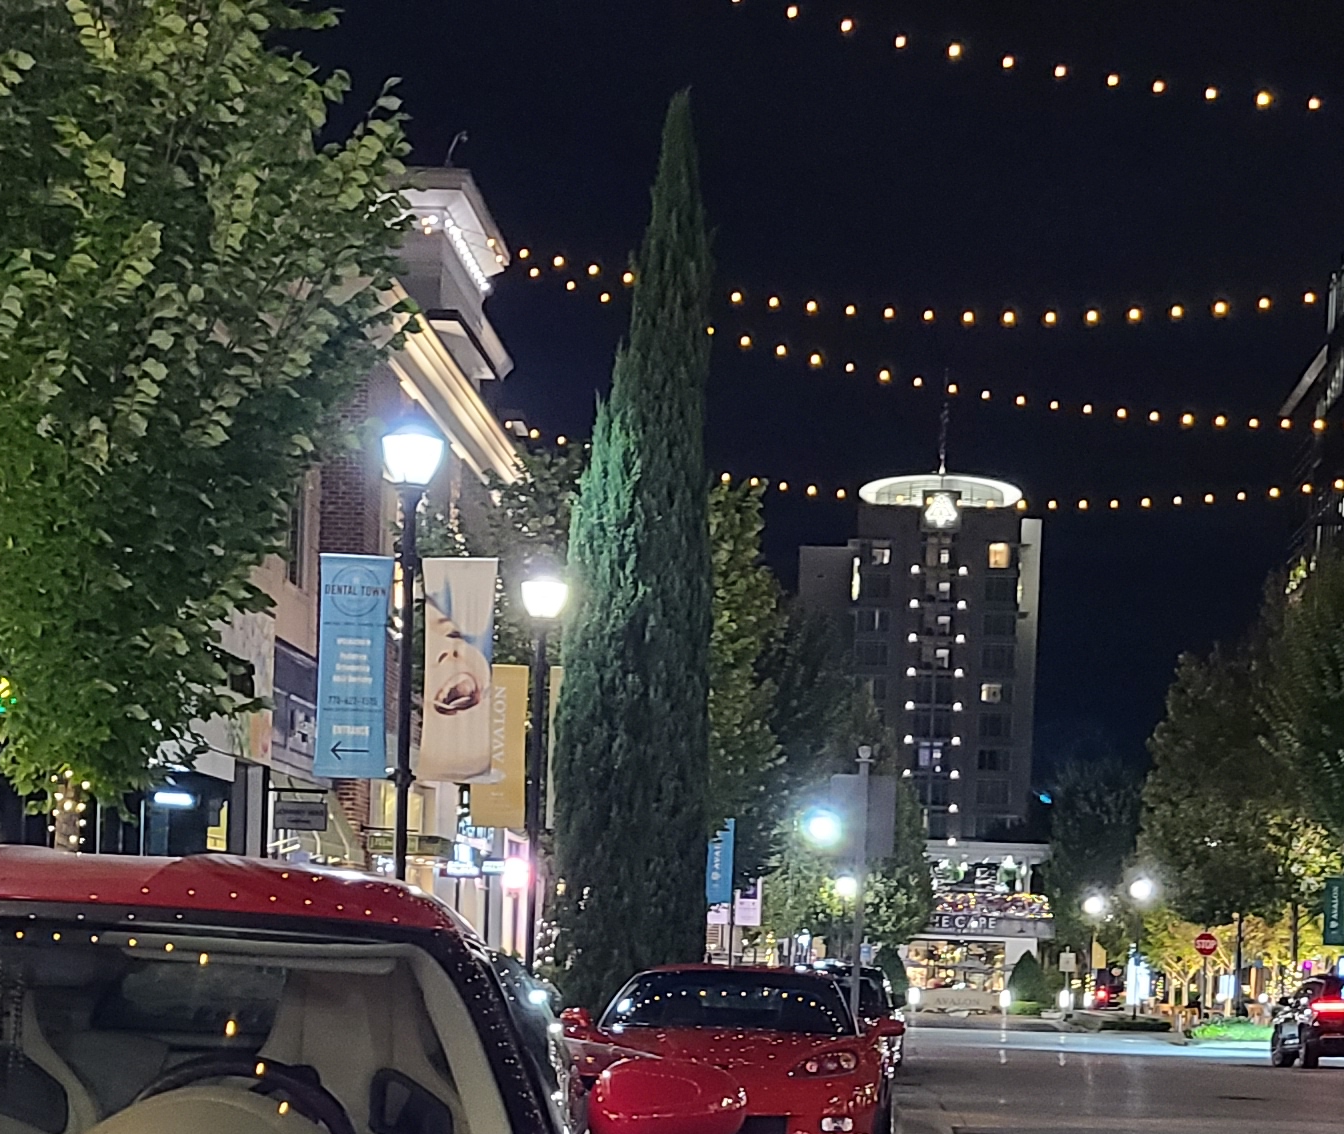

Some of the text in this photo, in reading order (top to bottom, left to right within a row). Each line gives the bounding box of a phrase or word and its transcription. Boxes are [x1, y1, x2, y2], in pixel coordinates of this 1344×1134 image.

[324, 584, 386, 597] DENTAL TOWN
[492, 686, 507, 764] AVALON
[1330, 886, 1340, 919] AVALON
[1196, 939, 1217, 950] STOP
